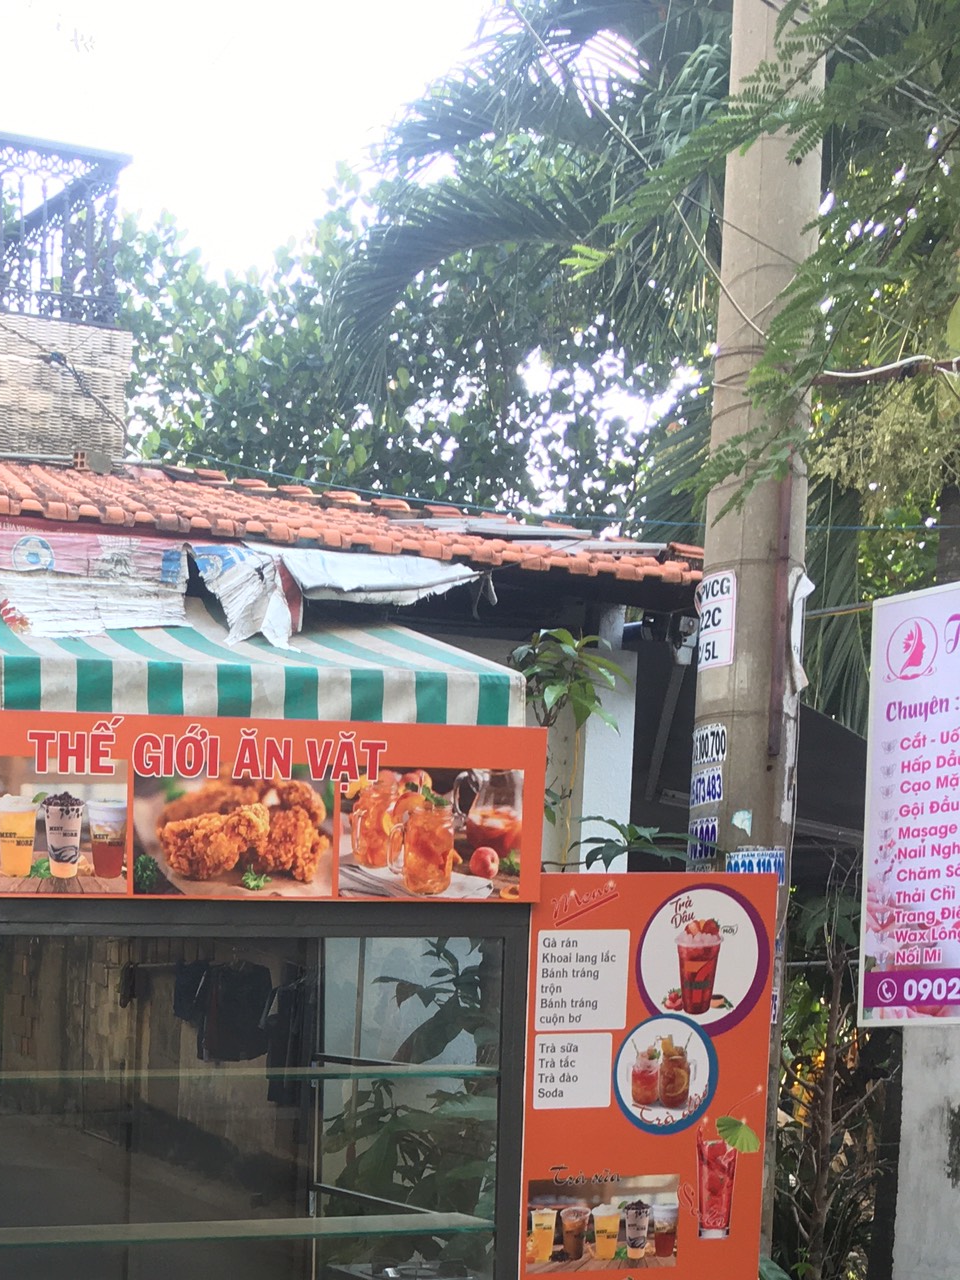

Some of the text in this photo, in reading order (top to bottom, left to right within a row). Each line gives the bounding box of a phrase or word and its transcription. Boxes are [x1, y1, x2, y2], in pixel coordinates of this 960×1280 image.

[885, 695, 950, 723] Chuyên
[900, 731, 927, 751] Cắt
[27, 716, 387, 792] THẾ GIỚI ĂN VẶT
[901, 754, 931, 775] Hấp
[900, 780, 932, 797] Cạo
[898, 795, 960, 820] Gội Đầu
[898, 823, 958, 841] Masage
[897, 844, 926, 861] Nail
[896, 866, 940, 882] Chăm
[896, 887, 926, 904] Thải
[894, 909, 935, 925] Trang
[542, 937, 578, 948] Gà rán
[895, 929, 927, 944] Wax
[542, 949, 616, 965] Khoai lang lắc
[896, 947, 941, 964] Nối Mi
[541, 967, 599, 980] Bánh tráng
[540, 983, 562, 996] trộn
[540, 997, 598, 1010] Bánh tráng
[539, 1013, 582, 1026] cuộn bơ
[539, 1041, 579, 1054] Trà sữa
[538, 1055, 576, 1069] Trà tắc
[538, 1072, 579, 1083] Trà đào
[538, 1087, 564, 1098] Soda
